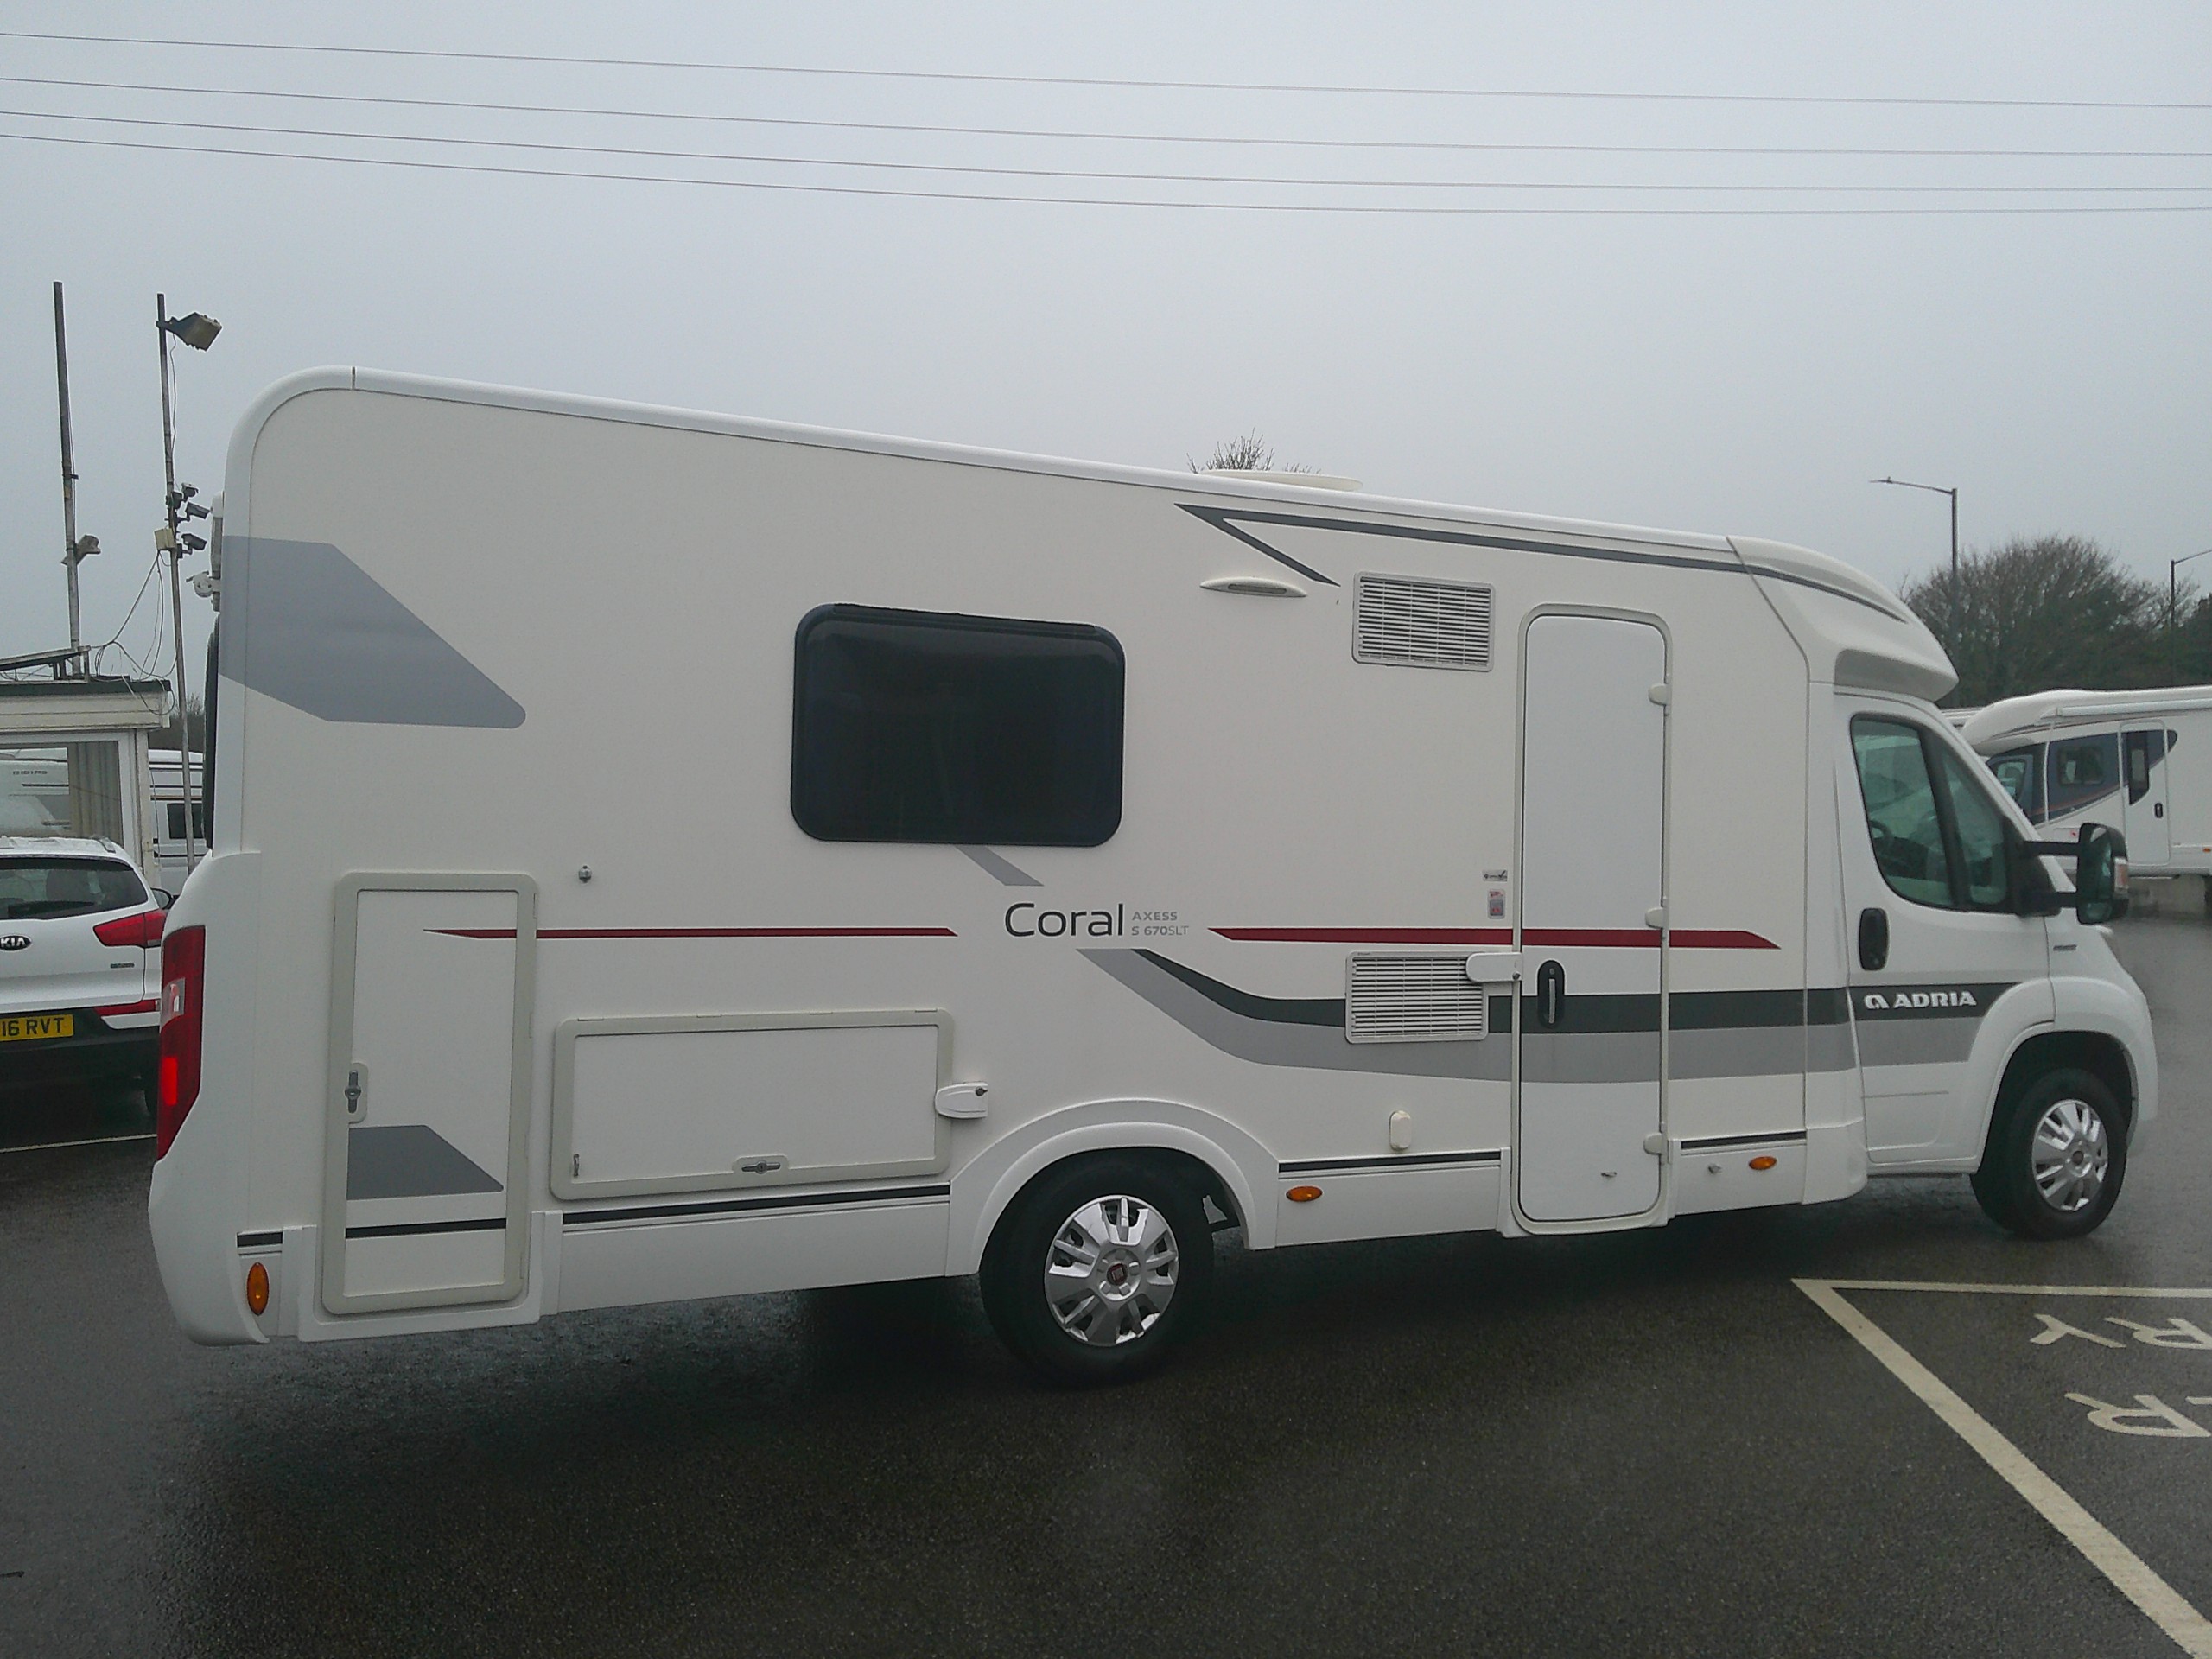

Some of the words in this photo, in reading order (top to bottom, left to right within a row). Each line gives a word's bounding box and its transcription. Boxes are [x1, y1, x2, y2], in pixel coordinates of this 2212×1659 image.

[1004, 902, 1124, 937] Coral
[1132, 911, 1178, 921] AXESS
[1131, 926, 1140, 936] S
[1143, 925, 1190, 936] 670SLT
[0, 937, 26, 948] KIA
[1892, 990, 1977, 1009] ADRIA
[26, 1017, 65, 1035] RVT
